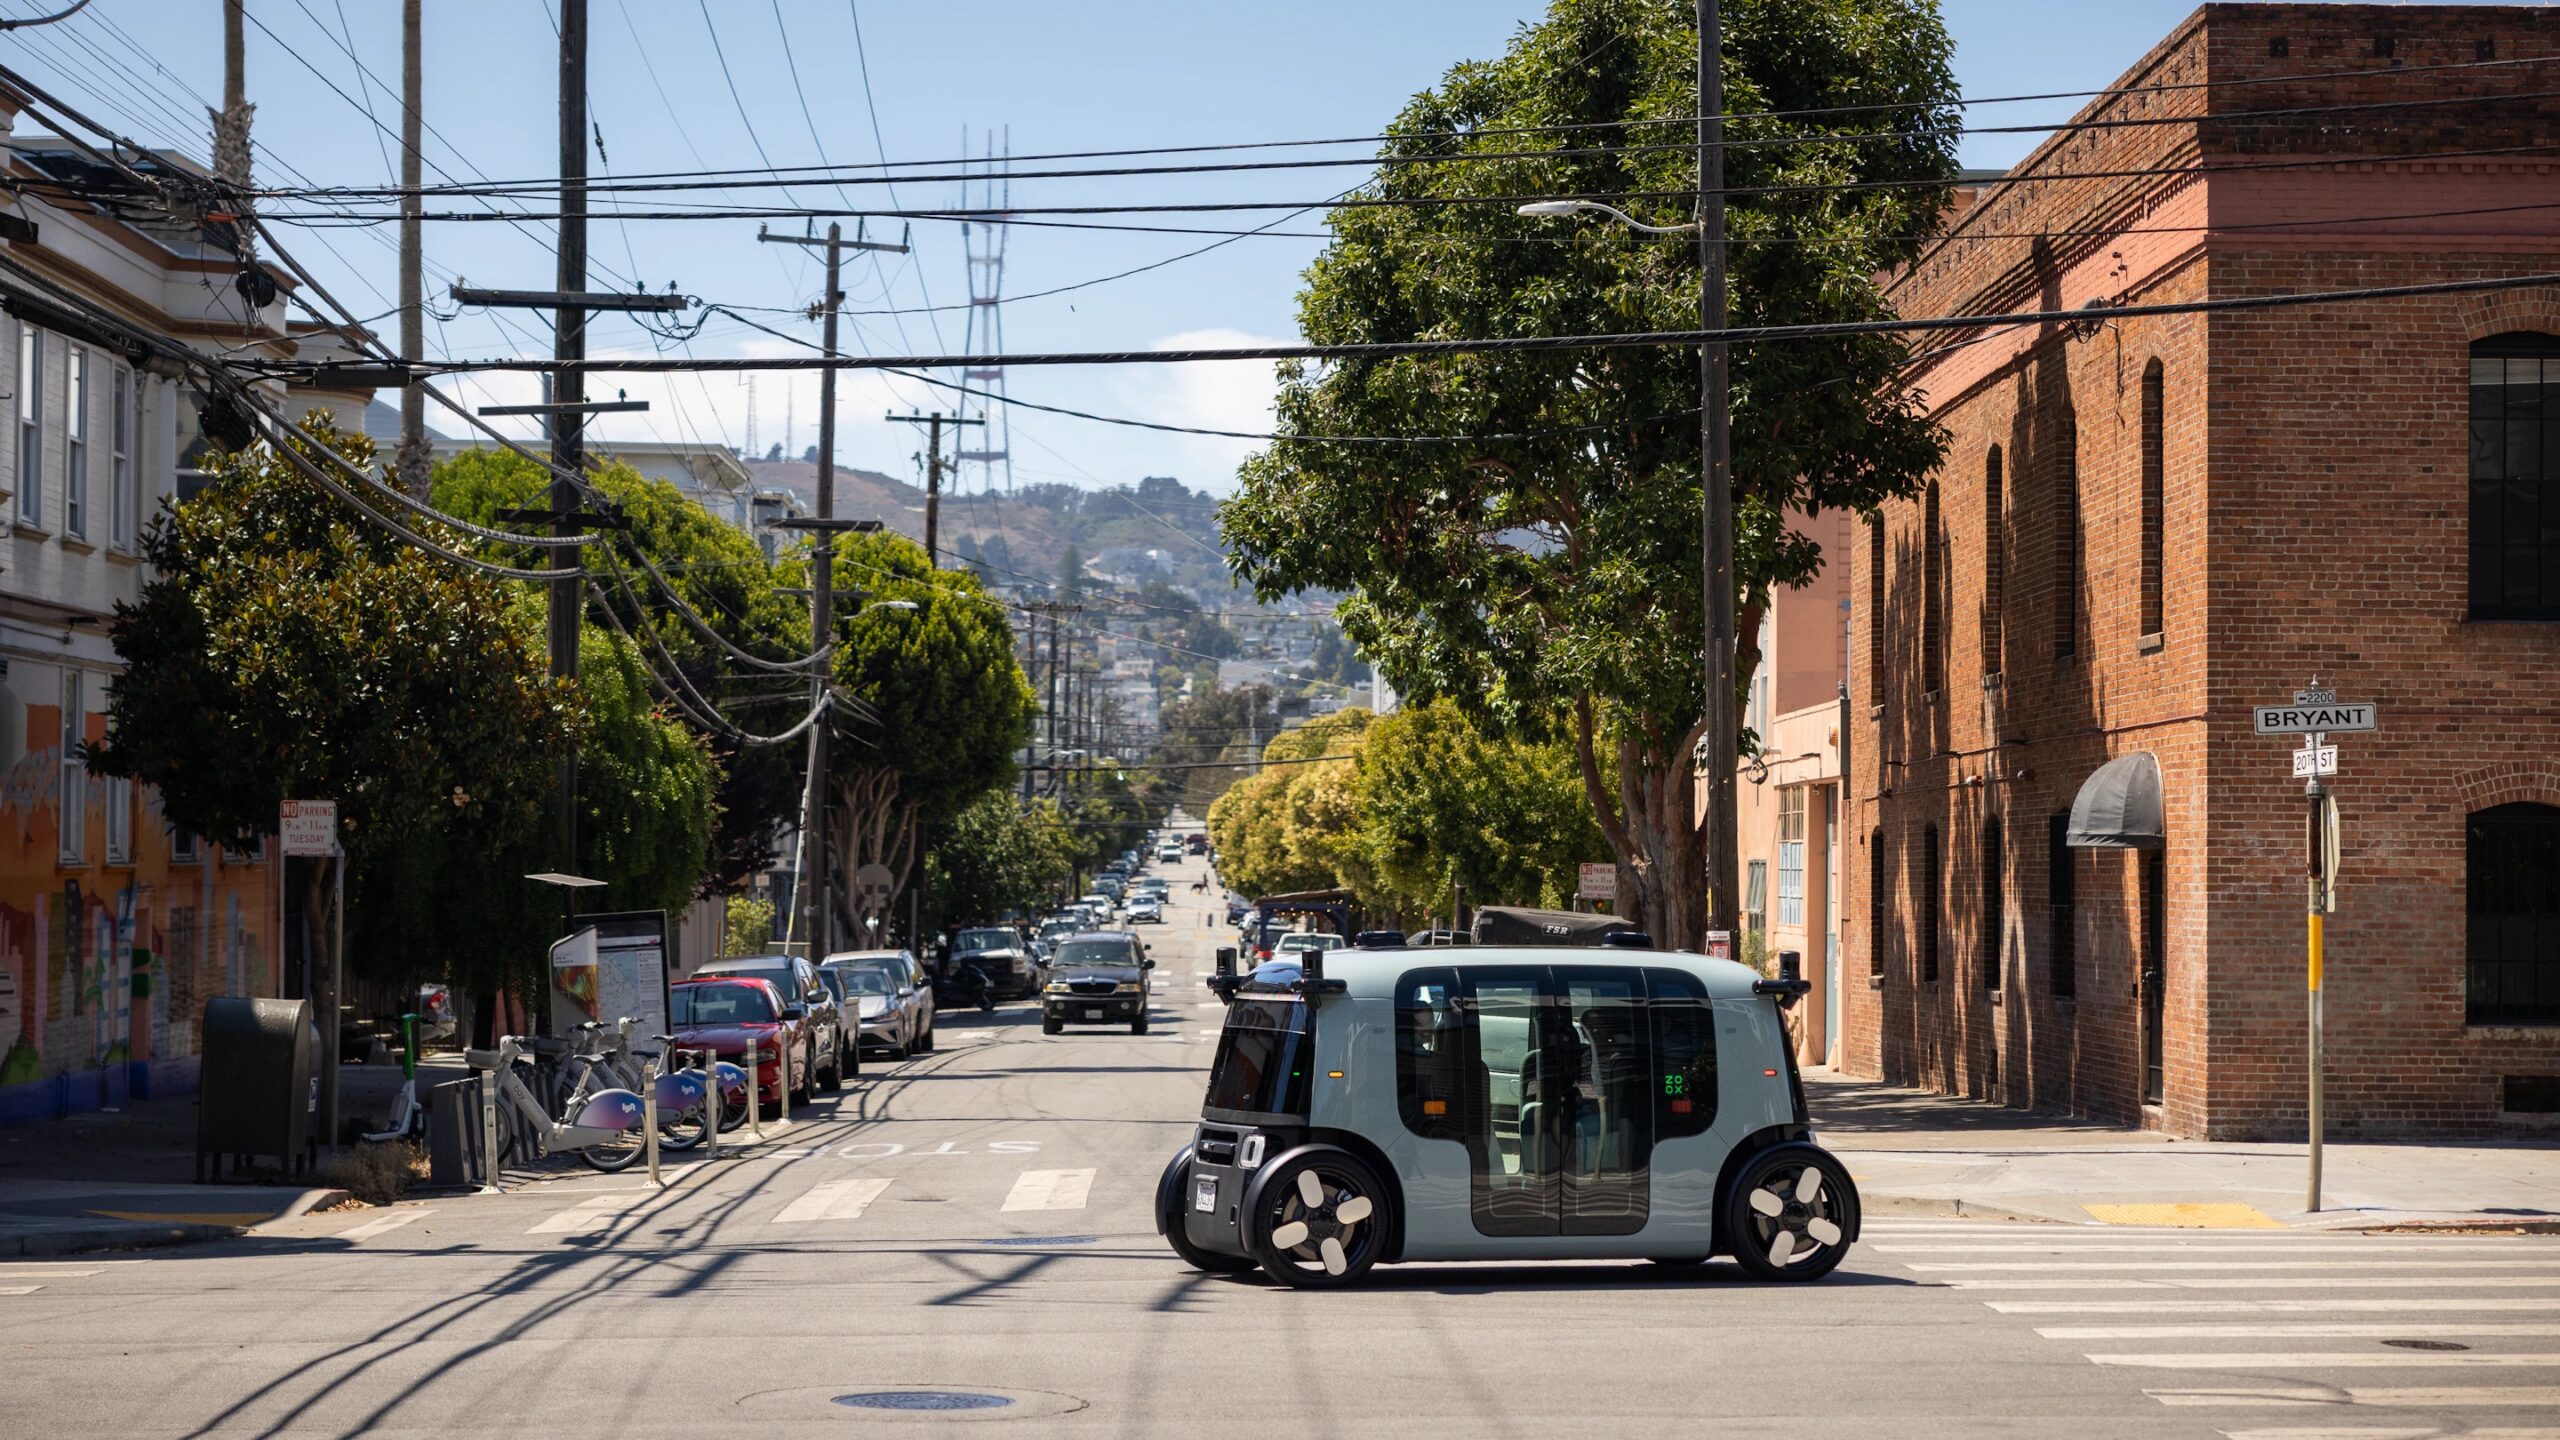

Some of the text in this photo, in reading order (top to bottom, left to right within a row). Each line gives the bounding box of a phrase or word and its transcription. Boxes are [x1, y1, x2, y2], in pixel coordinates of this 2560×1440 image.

[2306, 693, 2334, 703] 2200
[2264, 709, 2366, 727] BRYANT
[2320, 751, 2334, 767] ST
[282, 802, 333, 817] NO PARKING
[290, 834, 325, 844] TUESDAY
[1545, 925, 1568, 935] FSR
[724, 1072, 737, 1081] lyft
[681, 1085, 695, 1095] lyft
[622, 1103, 636, 1113] lyft
